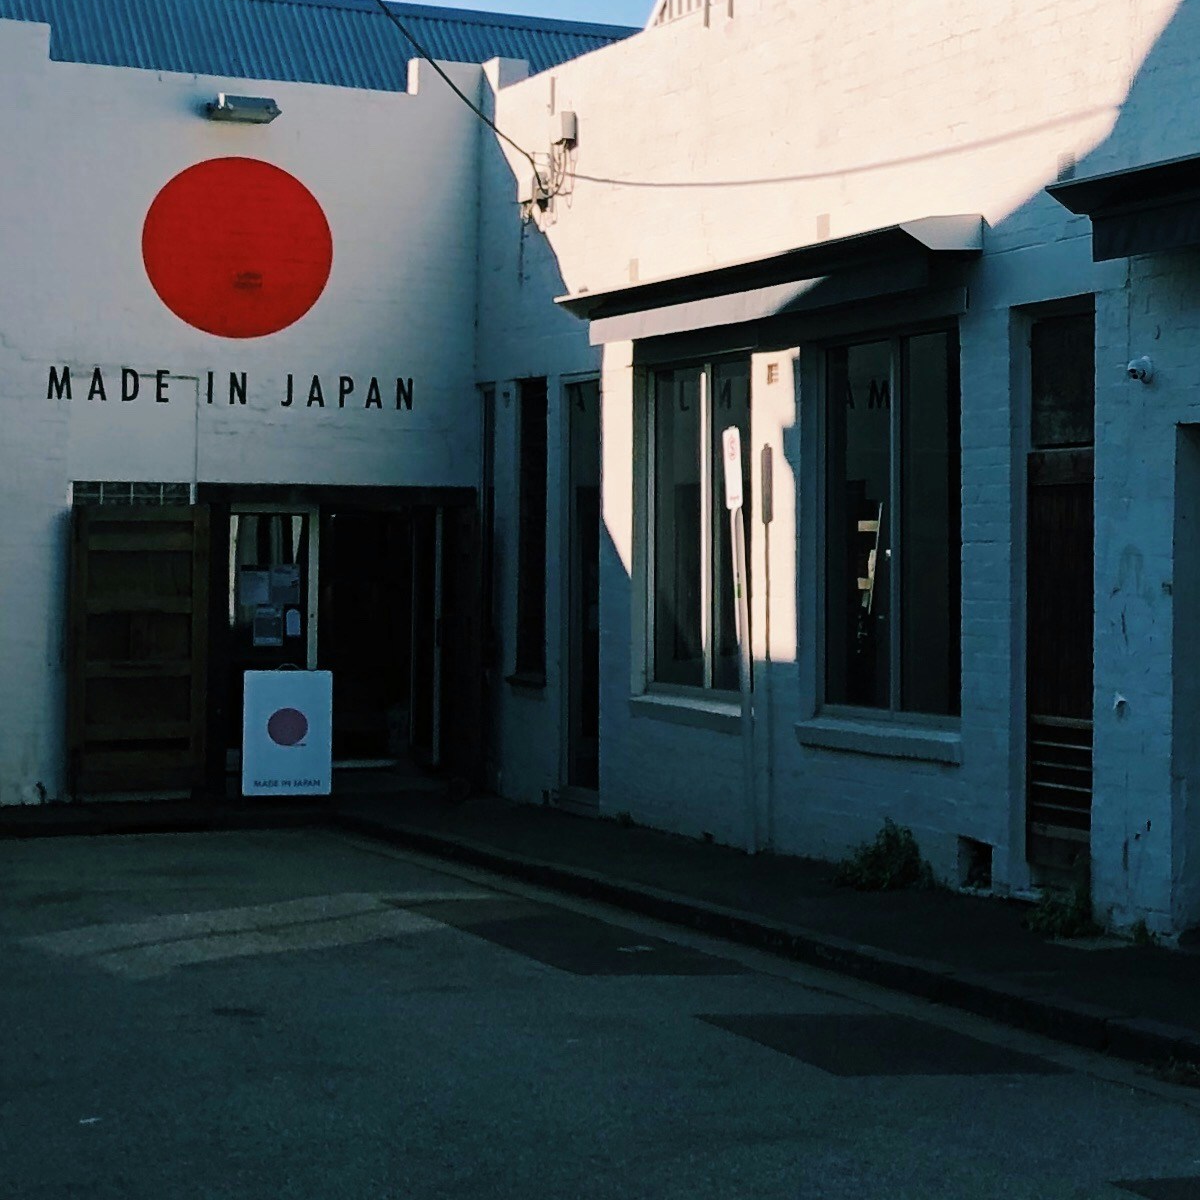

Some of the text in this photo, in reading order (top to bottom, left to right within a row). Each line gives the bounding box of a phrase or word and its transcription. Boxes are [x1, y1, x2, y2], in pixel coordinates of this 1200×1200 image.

[47, 365, 413, 410] MADE IN JAPAN
